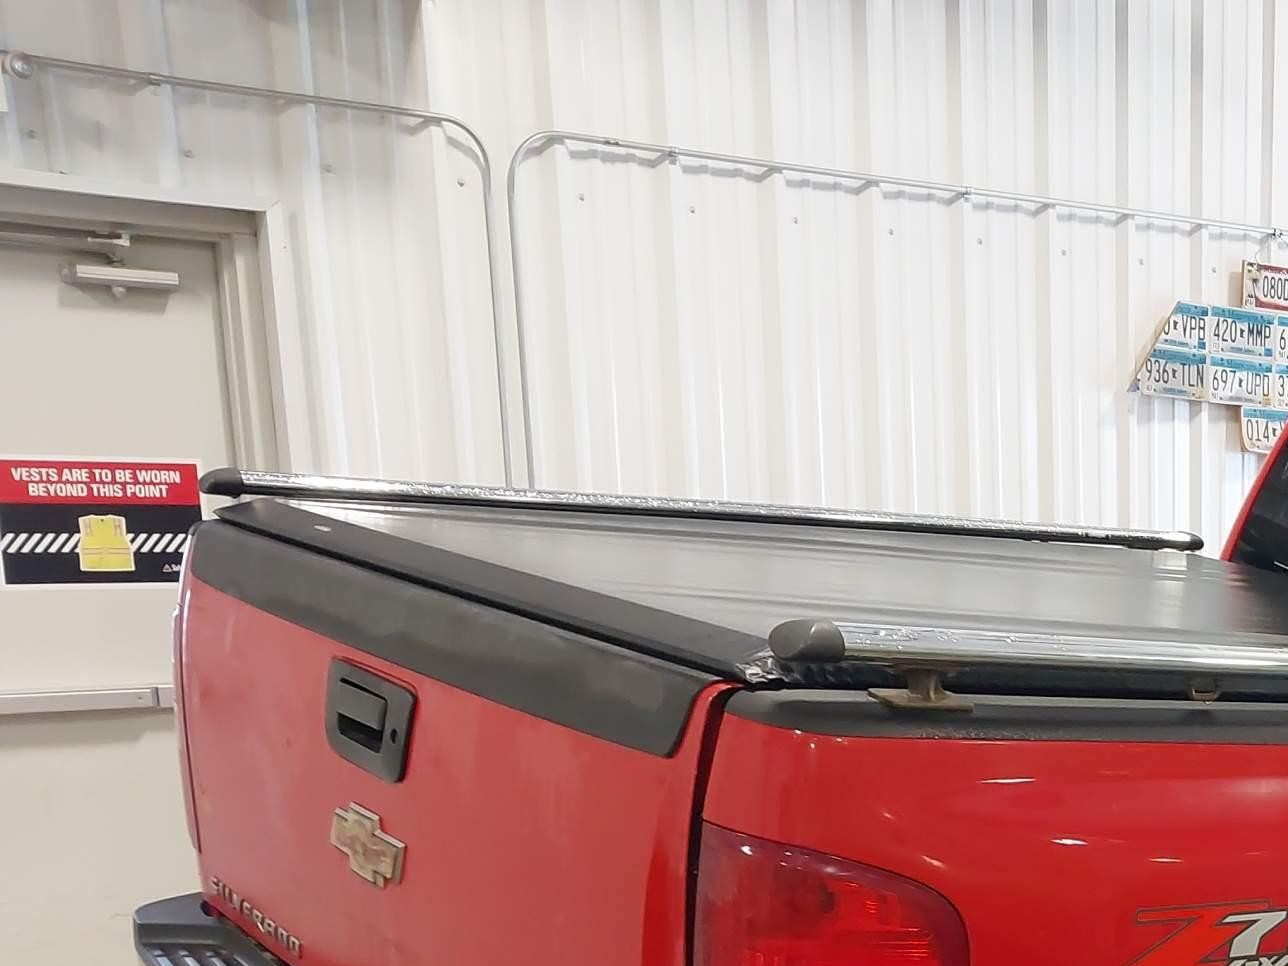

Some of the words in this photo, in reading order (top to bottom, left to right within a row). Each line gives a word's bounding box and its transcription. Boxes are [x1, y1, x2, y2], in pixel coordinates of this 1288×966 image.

[1181, 314, 1206, 341] VPB
[1213, 318, 1238, 343] 420
[1247, 322, 1271, 347] MMP
[1145, 358, 1170, 385] 936
[1180, 362, 1205, 389] TLN
[1212, 368, 1237, 393] 697
[1246, 419, 1270, 443] 014
[11, 467, 58, 482] VESTS
[62, 468, 91, 483] ARE
[94, 468, 112, 483] TO
[115, 469, 134, 484] BE
[136, 470, 181, 484] WORN
[28, 483, 88, 497] BEYOND
[90, 484, 123, 498] THIS
[126, 485, 168, 498] POINT
